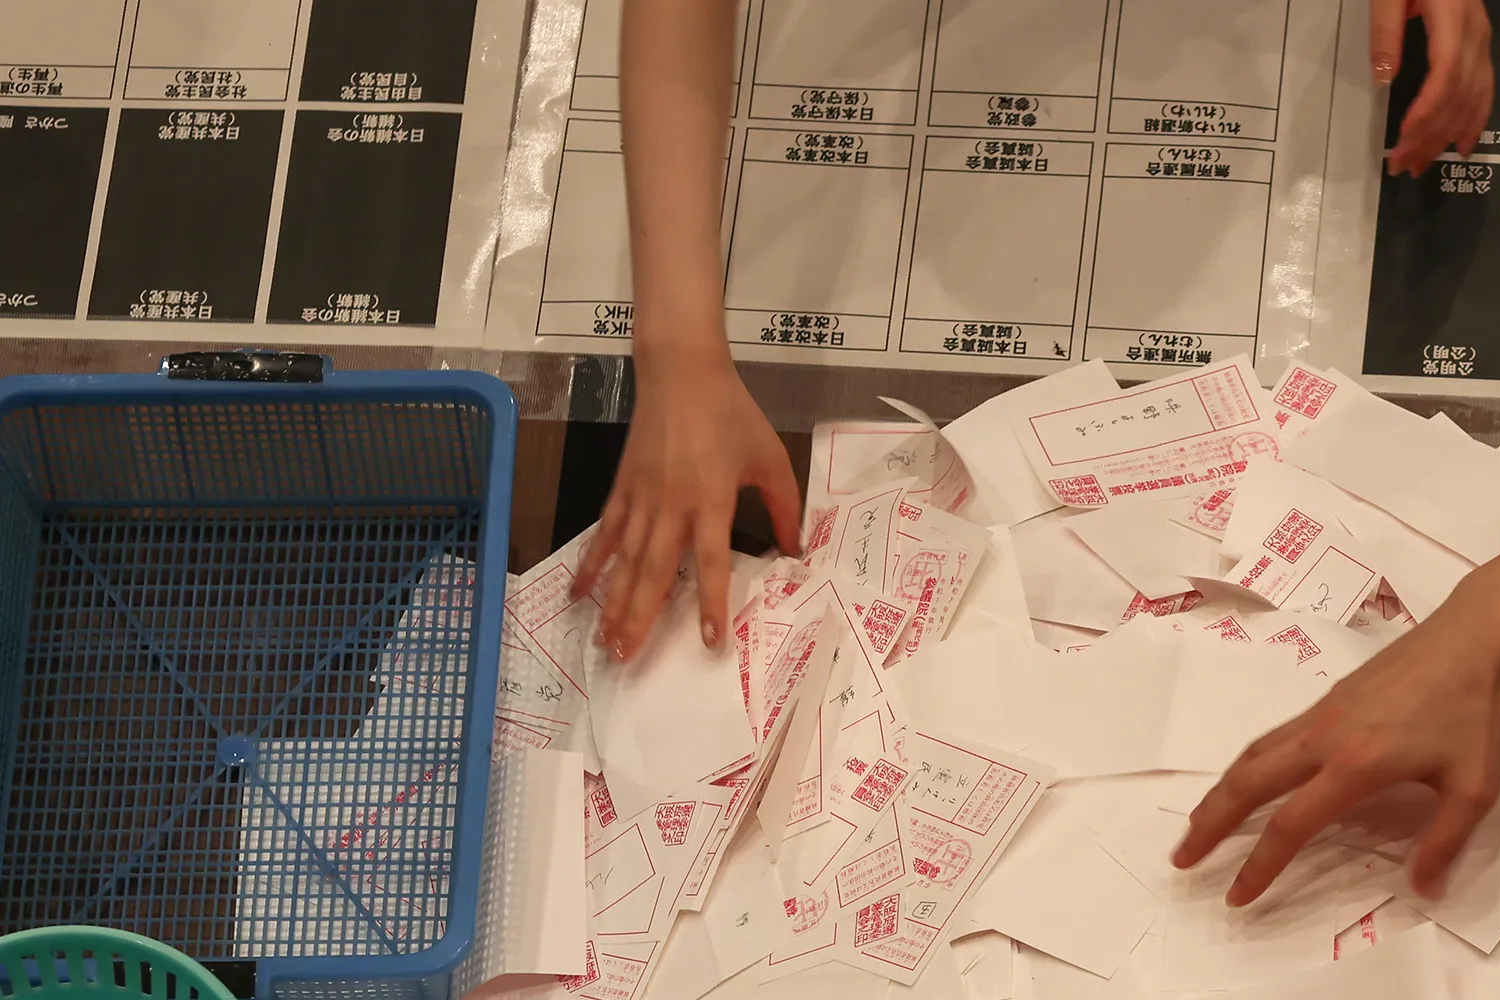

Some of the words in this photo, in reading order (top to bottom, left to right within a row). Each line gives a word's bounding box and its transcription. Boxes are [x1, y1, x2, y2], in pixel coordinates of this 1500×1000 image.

[8, 67, 58, 81] （再生）
[174, 69, 241, 84] （社民党）
[349, 71, 417, 87] （自民党）
[164, 84, 247, 99] 社会民主党
[340, 86, 421, 100] 自由民主党
[800, 89, 868, 105] （保守党）
[167, 111, 235, 126] （共産党）
[791, 104, 873, 120] 日本保守党
[986, 111, 1036, 126] 参政党
[1160, 102, 1225, 119] （れいわ）
[24, 115, 68, 128] つかさ
[352, 113, 404, 128] （維新）
[1144, 118, 1240, 134] れいわ新選組
[158, 125, 240, 139] 日本共産党
[327, 127, 423, 142] 日本維新の会
[793, 133, 863, 149] （改革党）
[973, 140, 1042, 156] （誠真会）
[785, 147, 867, 164] 日本改革党
[1157, 147, 1220, 162] （むれん）
[965, 156, 1047, 171] 日本誠真会
[1145, 161, 1230, 177] 無所属連合
[1439, 163, 1492, 179] （公明）
[1440, 178, 1490, 193] 公明党
[139, 289, 207, 304] （共産党）
[327, 292, 379, 308] （維新）
[129, 303, 211, 319] 日本共産党
[301, 307, 400, 323] 日本維新の会
[593, 305, 633, 320] HK）
[593, 320, 633, 335] HK党
[770, 313, 839, 329] （改革党）
[760, 328, 844, 345] 日本改革党
[951, 323, 1021, 338] （誠真会）
[942, 337, 1026, 354] 日本誠真会
[1138, 332, 1202, 348] （むれん）
[1126, 345, 1211, 363] 無所属連合
[1422, 344, 1475, 359] （公明）
[1422, 359, 1473, 375] 公明党
